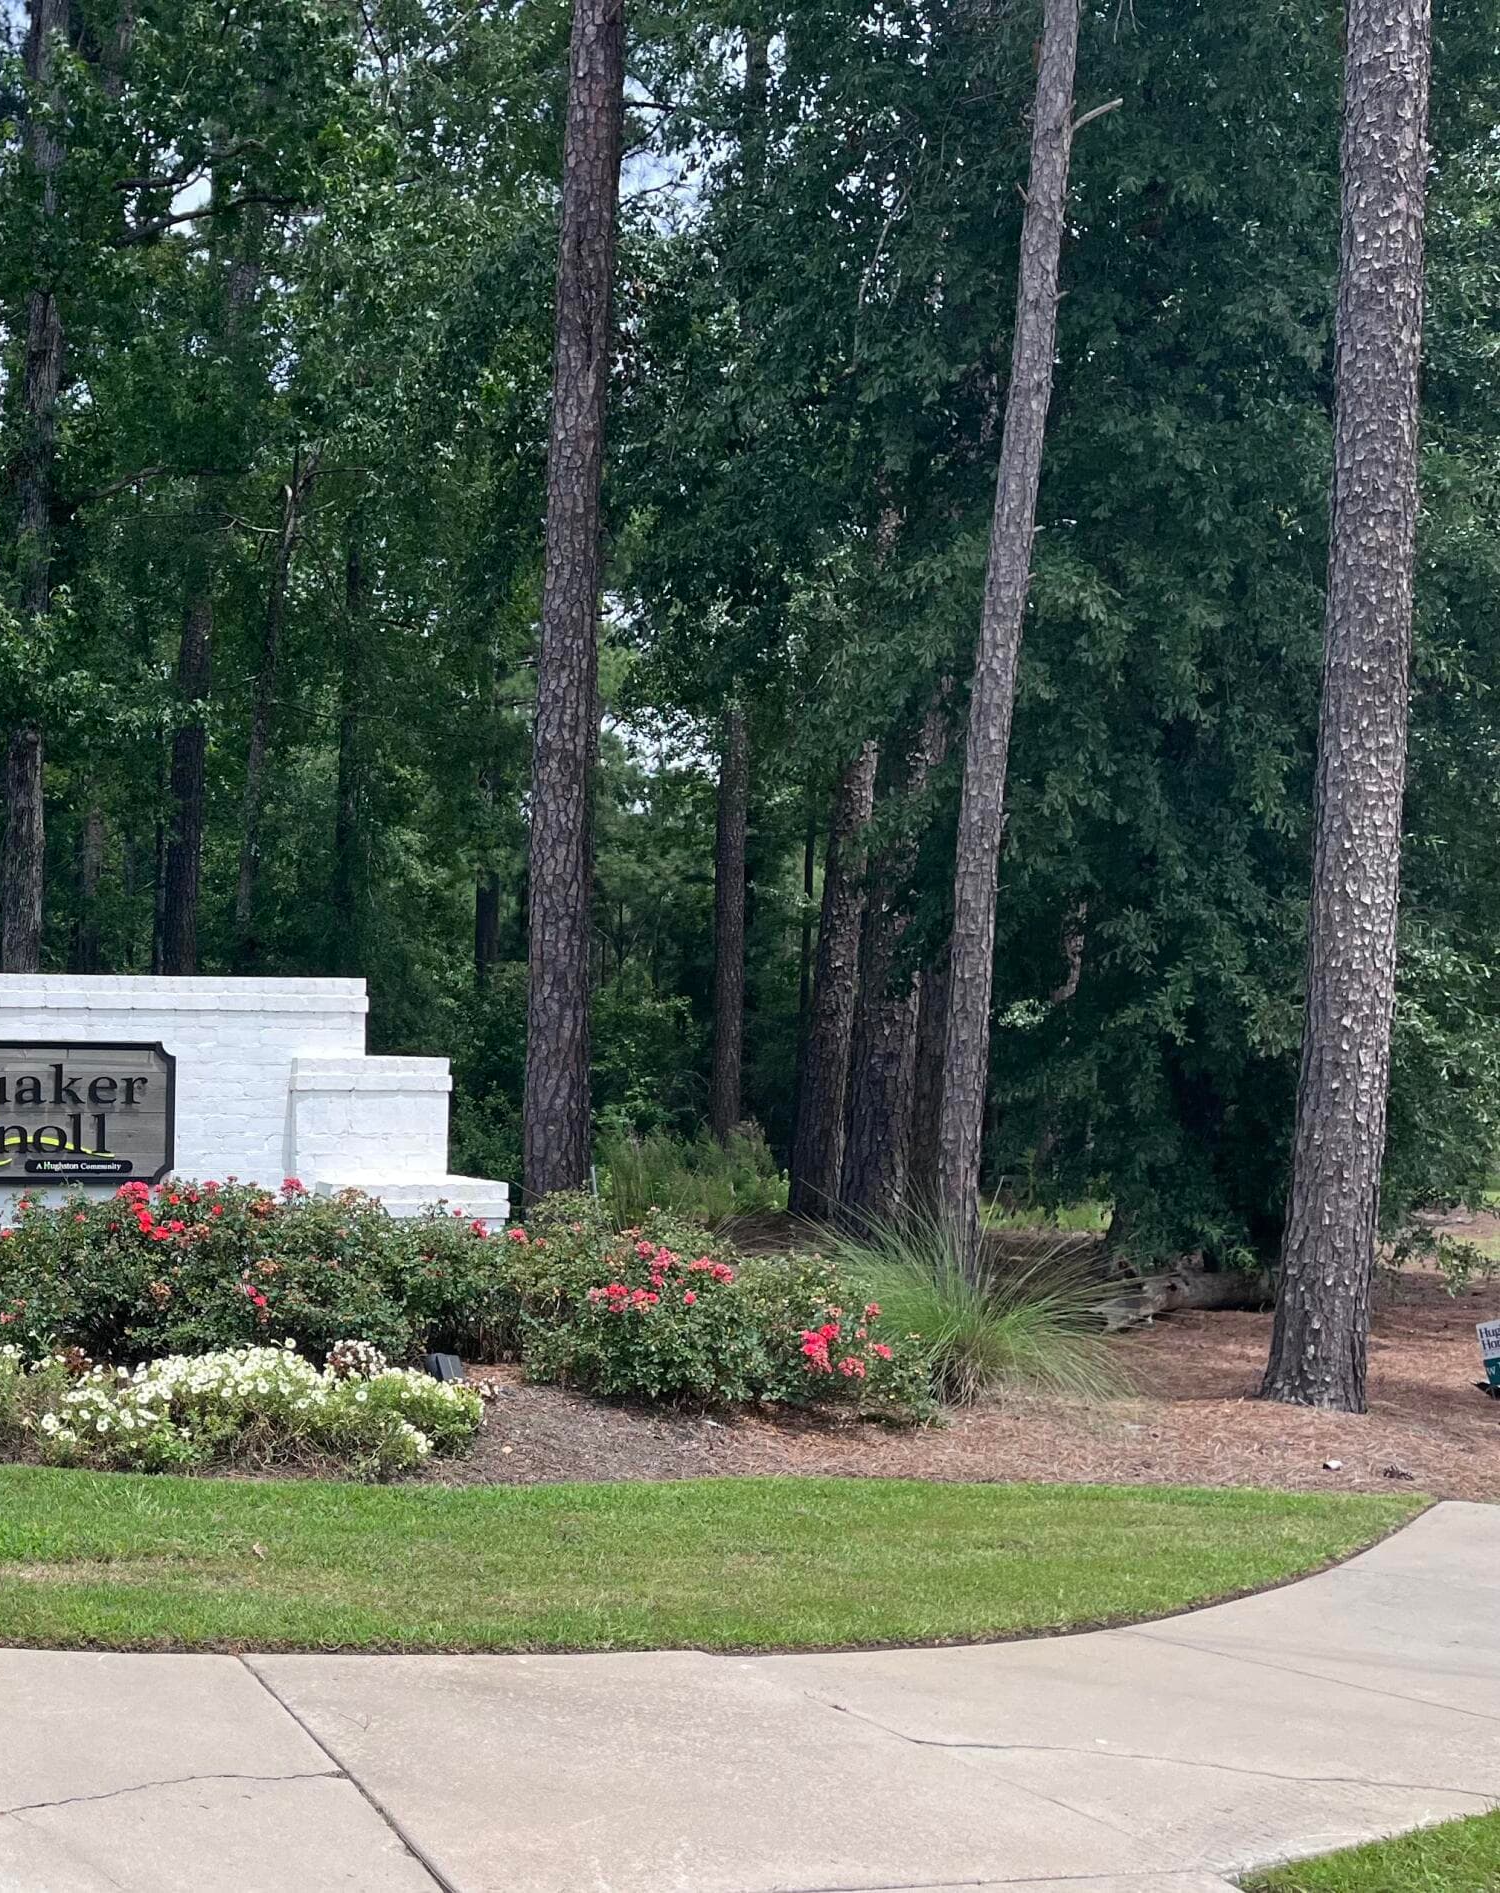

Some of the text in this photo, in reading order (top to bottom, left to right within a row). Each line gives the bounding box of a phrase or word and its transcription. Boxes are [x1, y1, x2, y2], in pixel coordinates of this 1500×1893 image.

[36, 1161, 122, 1171] A Hughston Community
